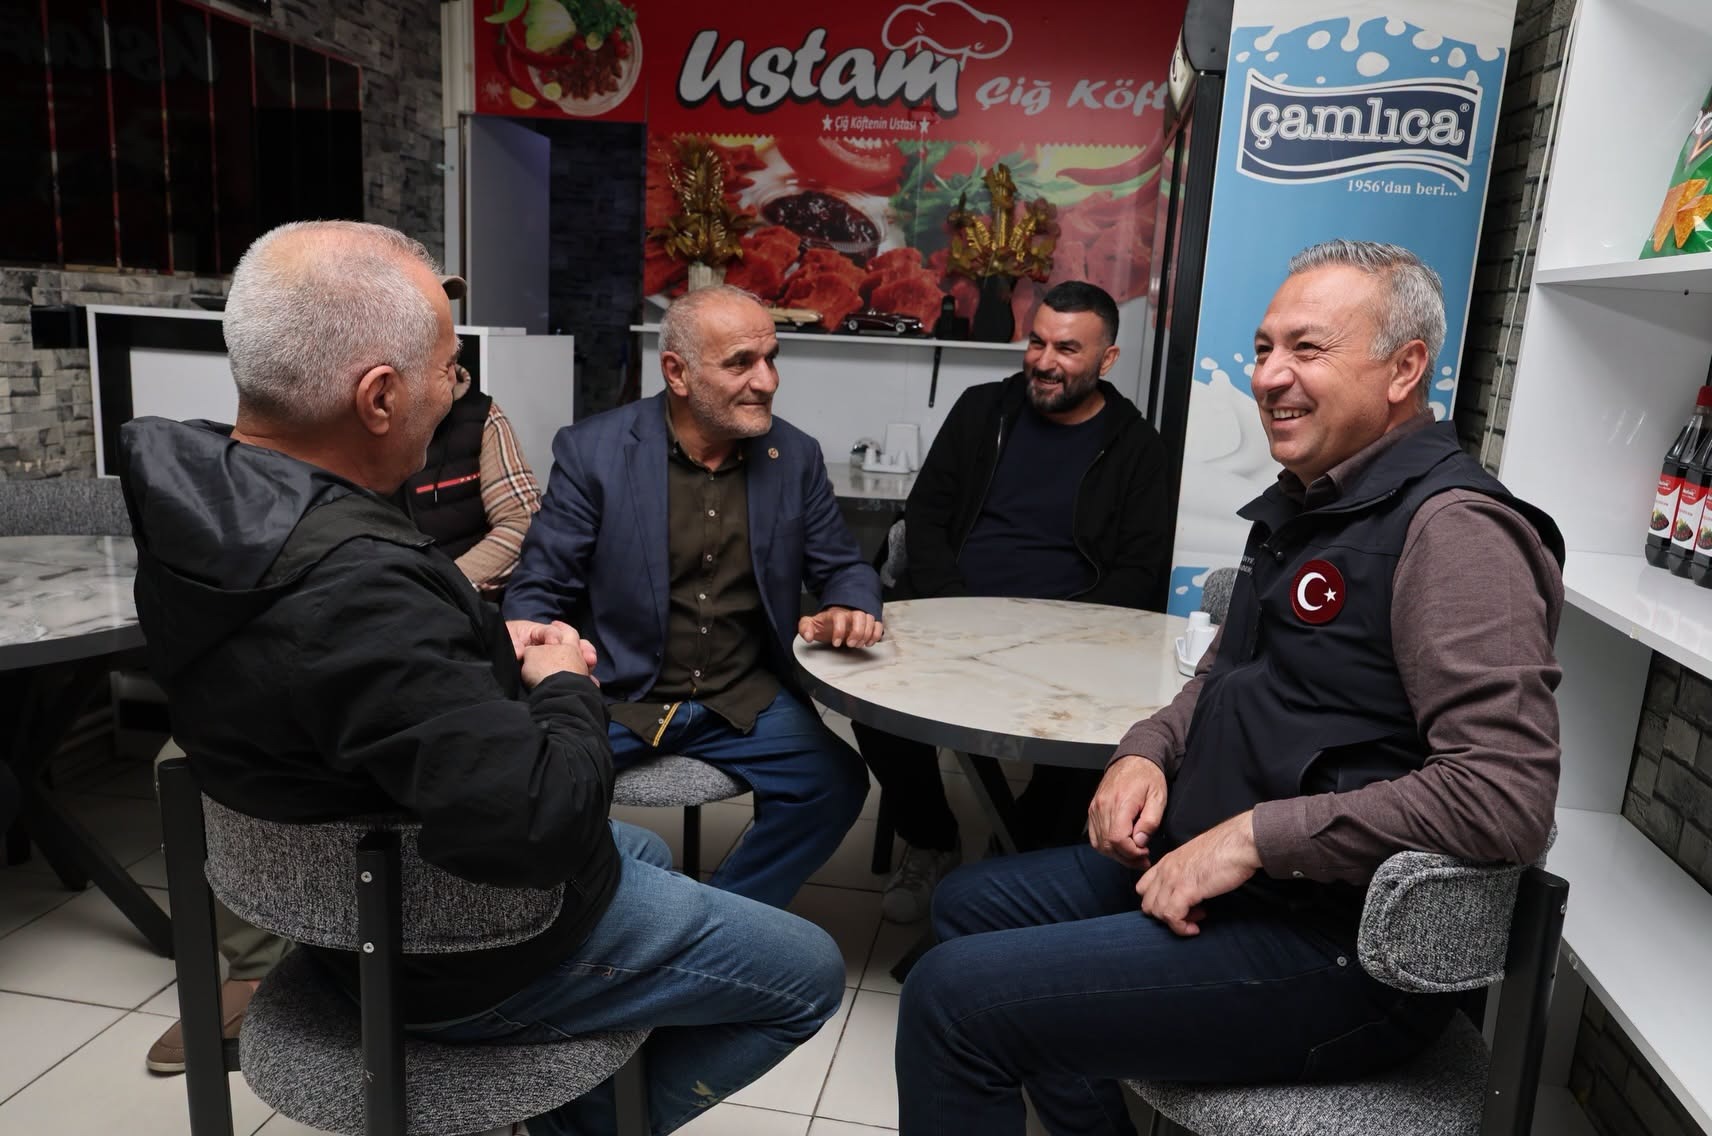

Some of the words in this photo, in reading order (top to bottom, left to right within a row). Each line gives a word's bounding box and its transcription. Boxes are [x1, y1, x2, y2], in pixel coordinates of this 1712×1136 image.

[677, 27, 960, 118] Ustam
[975, 76, 1053, 116] Çiğ
[1066, 79, 1169, 117] Köft
[835, 116, 848, 131] Çiğ
[851, 116, 887, 132] Köftenin
[889, 117, 917, 131] Ustası
[1250, 97, 1465, 150] çamlıca
[1346, 179, 1411, 195] 1956'dan
[1415, 180, 1458, 197] beri...
